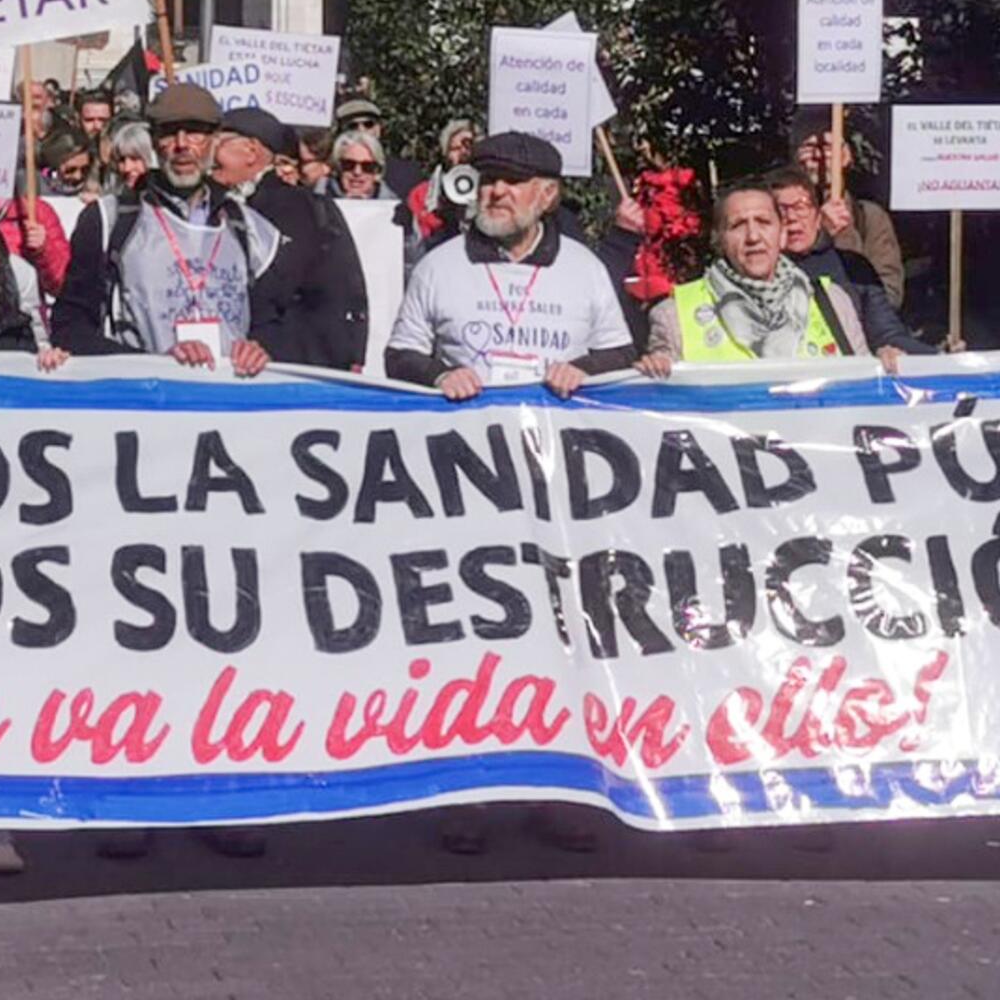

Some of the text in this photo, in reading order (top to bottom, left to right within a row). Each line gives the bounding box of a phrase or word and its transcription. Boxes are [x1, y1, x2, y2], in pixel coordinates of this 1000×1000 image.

[819, 13, 862, 27] calidad
[817, 37, 863, 51] en cada
[500, 55, 586, 72] Atención de
[155, 62, 261, 93] SNIDAD
[515, 79, 567, 95] calidad
[513, 104, 569, 119] en cada
[492, 322, 571, 350] SANIDAD
[113, 428, 266, 515] LA
[291, 423, 818, 523] SANIDAD
[110, 543, 262, 653] SU
[29, 686, 171, 766] va
[190, 664, 305, 765] la
[324, 650, 572, 761] vida
[583, 689, 693, 769] en
